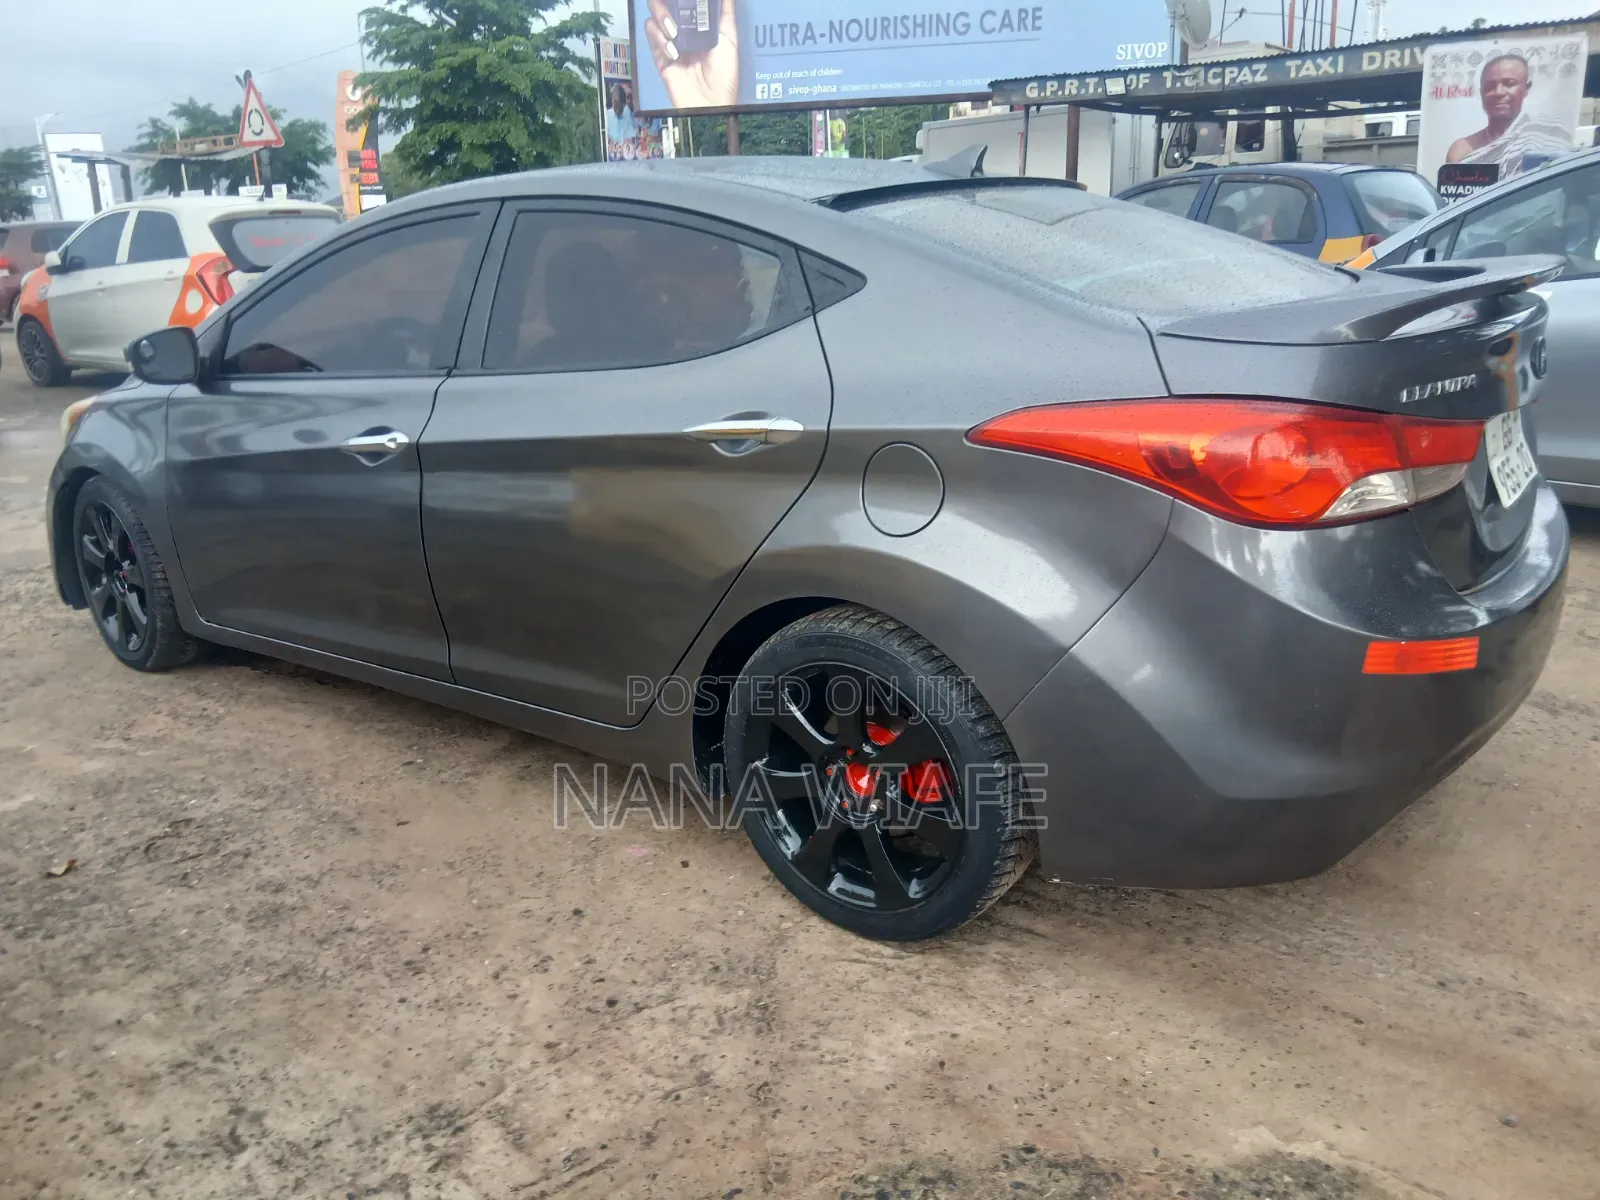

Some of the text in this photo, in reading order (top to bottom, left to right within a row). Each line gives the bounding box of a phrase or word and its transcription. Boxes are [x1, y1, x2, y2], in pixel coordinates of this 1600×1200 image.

[755, 7, 1043, 48] ULTRA-NOURISHING CARE
[1116, 42, 1168, 60] SIVOP
[756, 72, 771, 81] Keep
[817, 67, 842, 76] children
[1285, 54, 1344, 79] TAXI
[788, 84, 837, 95] sivop-ghana
